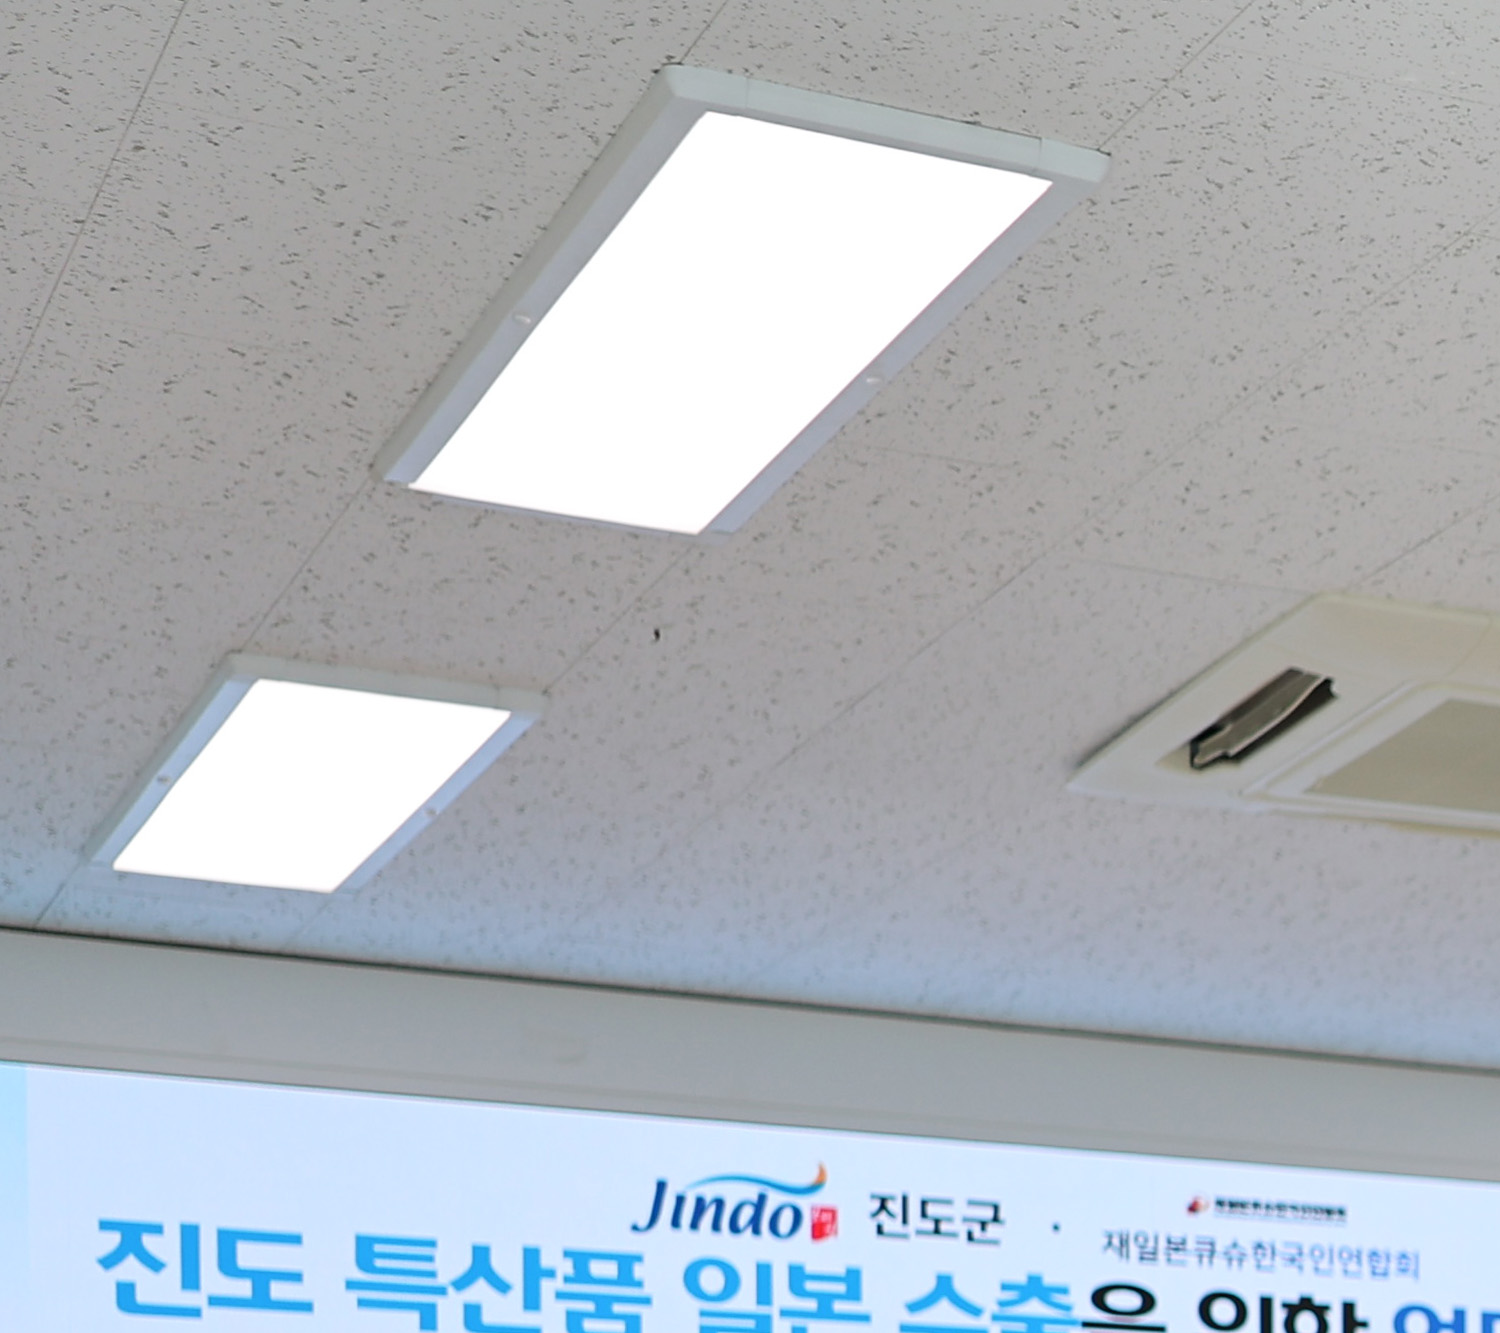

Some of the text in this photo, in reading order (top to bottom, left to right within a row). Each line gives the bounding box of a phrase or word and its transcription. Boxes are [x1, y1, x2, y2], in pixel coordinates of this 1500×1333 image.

[631, 1178, 803, 1240] Jindo
[868, 1191, 1006, 1246] 진도군
[94, 1214, 314, 1321] 진도
[1101, 1227, 1420, 1281] 재일본큐슈한국인연합회
